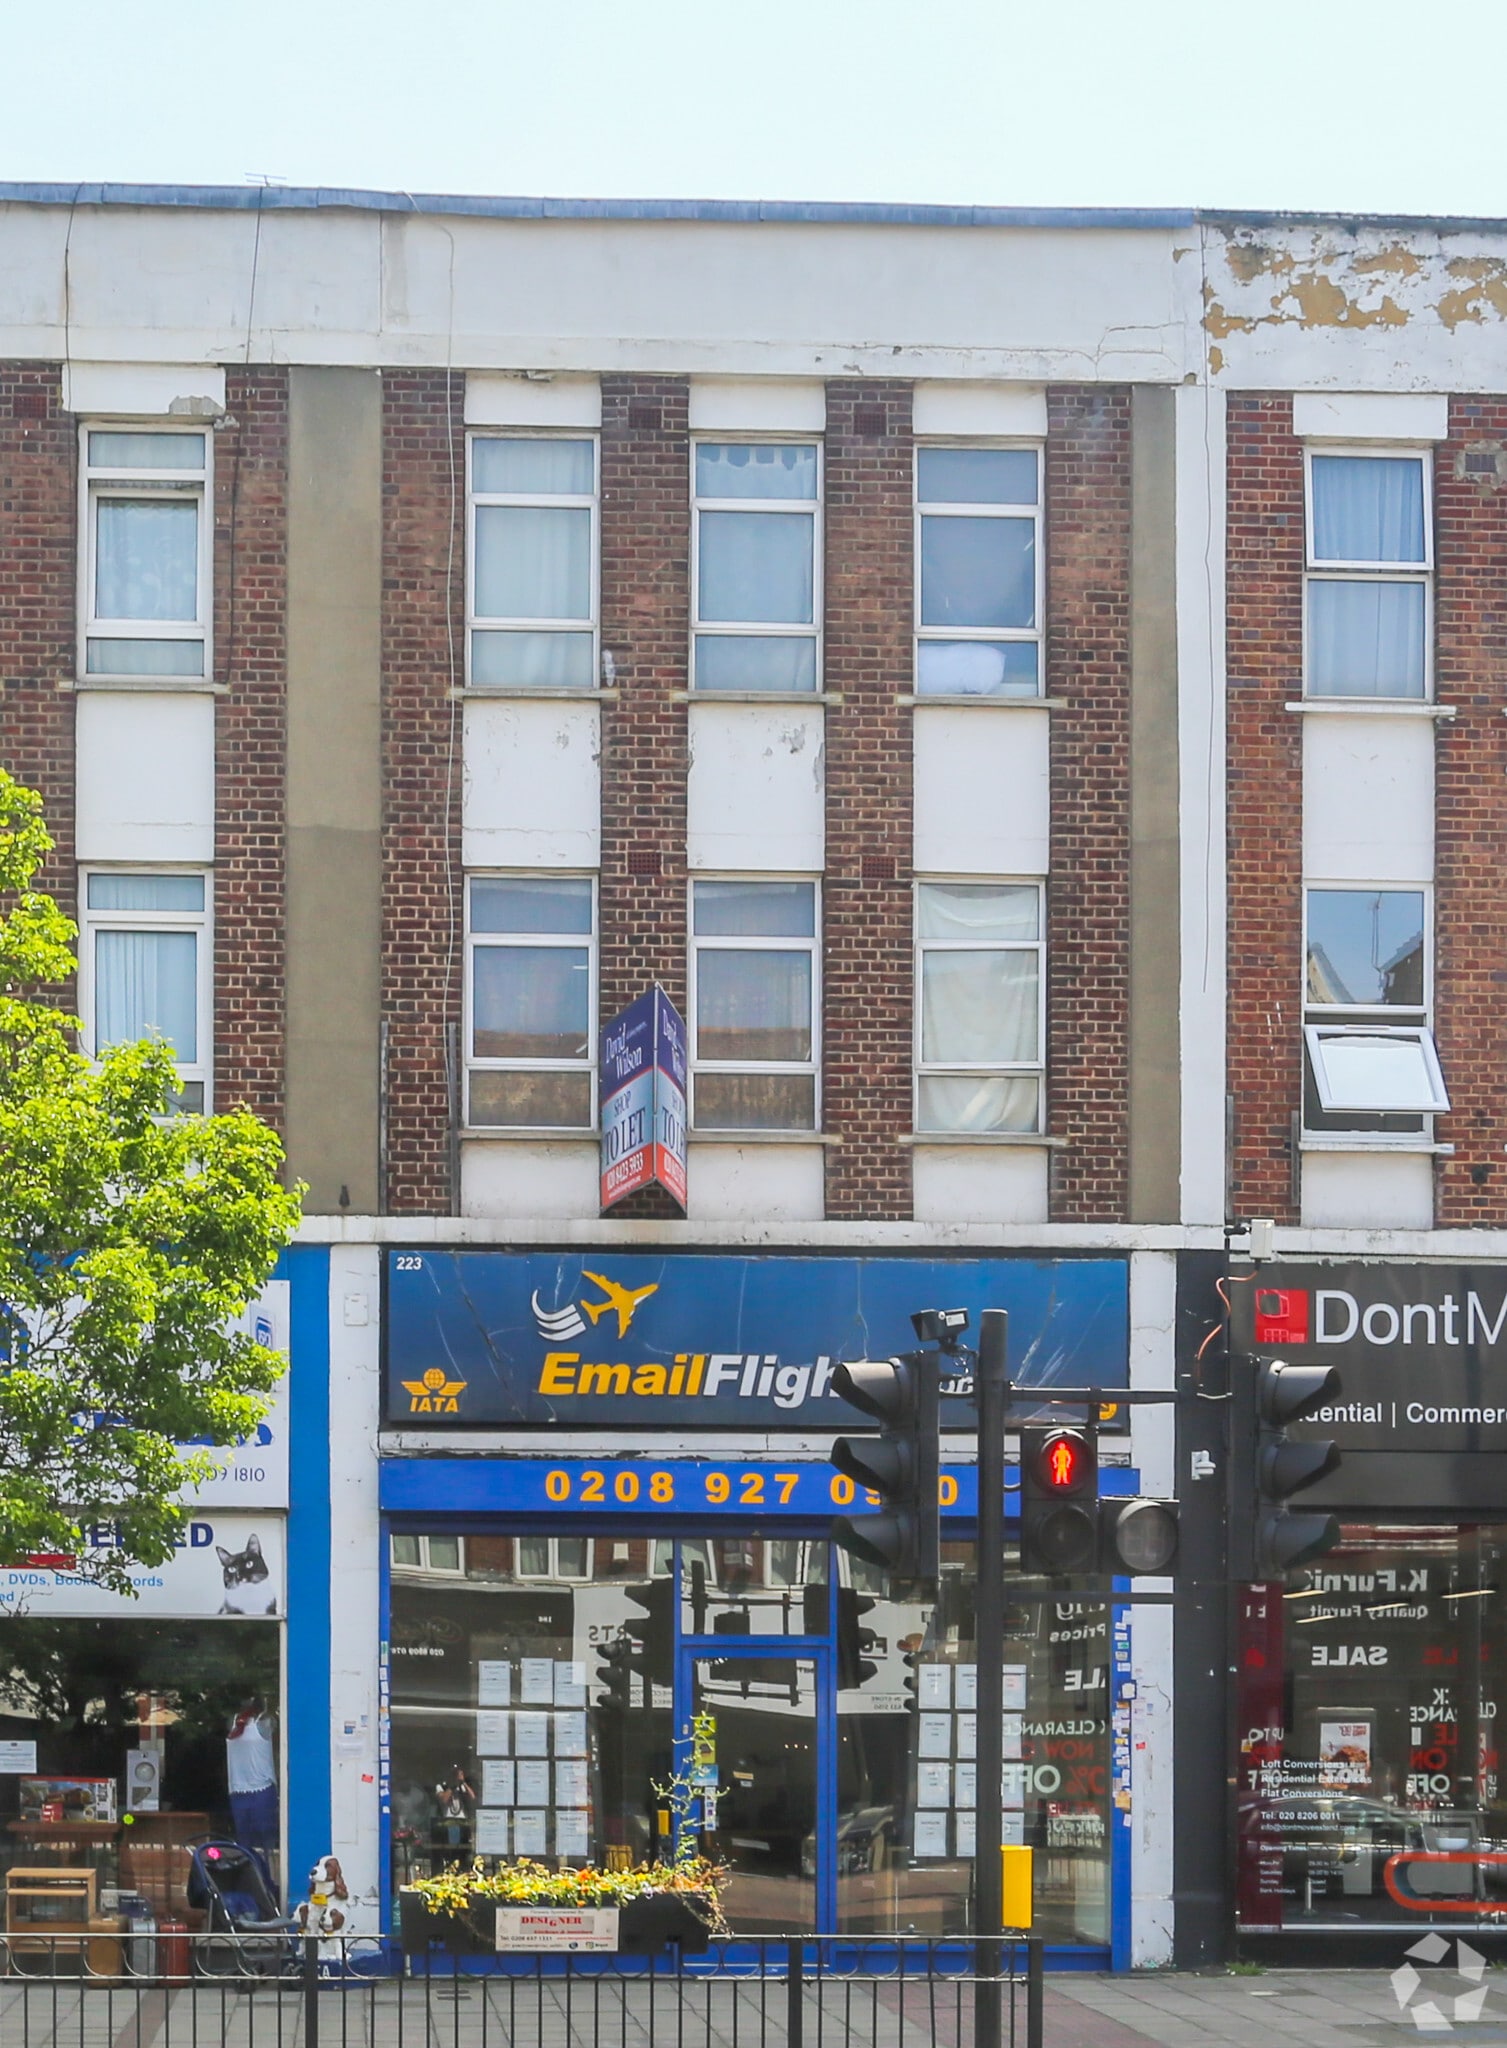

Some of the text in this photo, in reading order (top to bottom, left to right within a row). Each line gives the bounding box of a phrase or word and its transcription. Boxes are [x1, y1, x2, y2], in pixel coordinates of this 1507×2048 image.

[604, 1107, 646, 1166] TO LET
[396, 1257, 422, 1270] 223
[410, 1397, 460, 1413] IATA
[234, 1467, 266, 1482] 1810
[545, 1470, 675, 1502] 0208
[705, 1473, 799, 1505] 927
[8, 1573, 50, 1588] DVDs,
[1261, 1760, 1281, 1769] Loft
[1261, 1774, 1316, 1783] Residential
[1261, 1789, 1344, 1798] Flat Conversions
[1279, 1812, 1296, 1820] 020
[1297, 1812, 1319, 1820] 8206
[521, 1915, 582, 1927] DESIGNER
